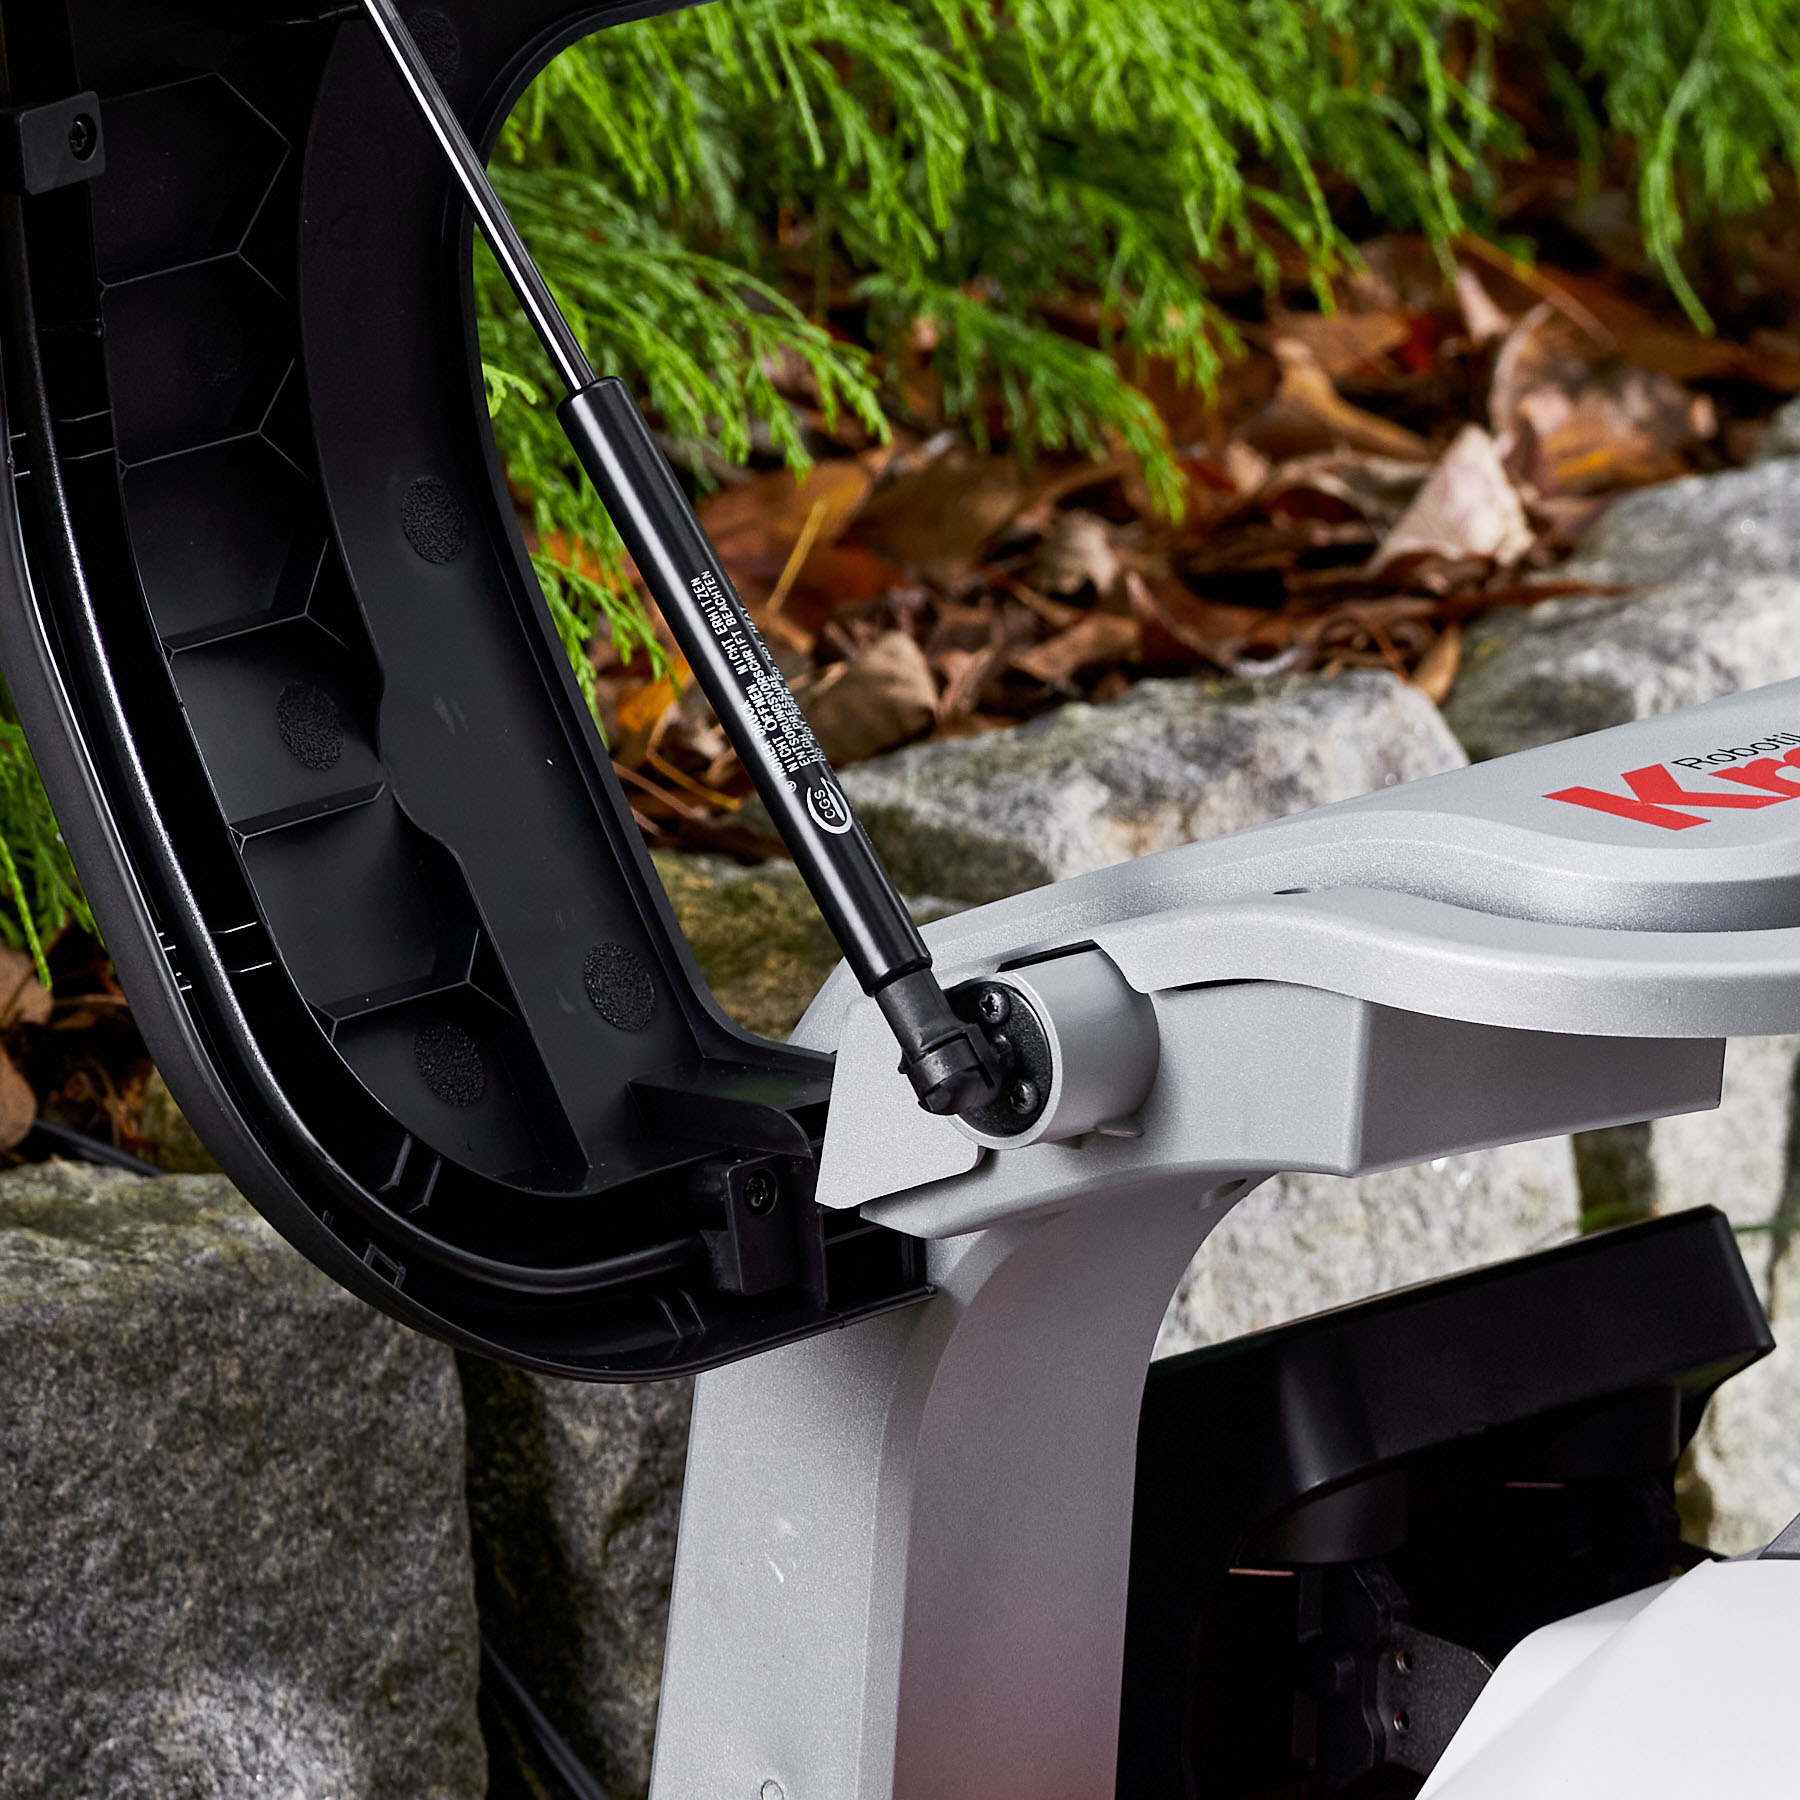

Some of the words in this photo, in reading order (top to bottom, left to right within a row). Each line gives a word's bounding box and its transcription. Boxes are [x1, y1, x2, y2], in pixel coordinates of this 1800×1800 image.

[690, 576, 727, 635] ERHITZEN
[701, 570, 736, 626] BEACHTEN
[722, 638, 747, 674] NICHT
[731, 630, 810, 766] ENTSORUNGSVORSCHRIFT
[767, 673, 801, 730] PRESSURE
[740, 700, 765, 738] DRUCK
[758, 740, 786, 778] HOHER
[773, 735, 798, 772] NICHT
[798, 734, 818, 762] HIGH
[813, 788, 836, 819] CGS
